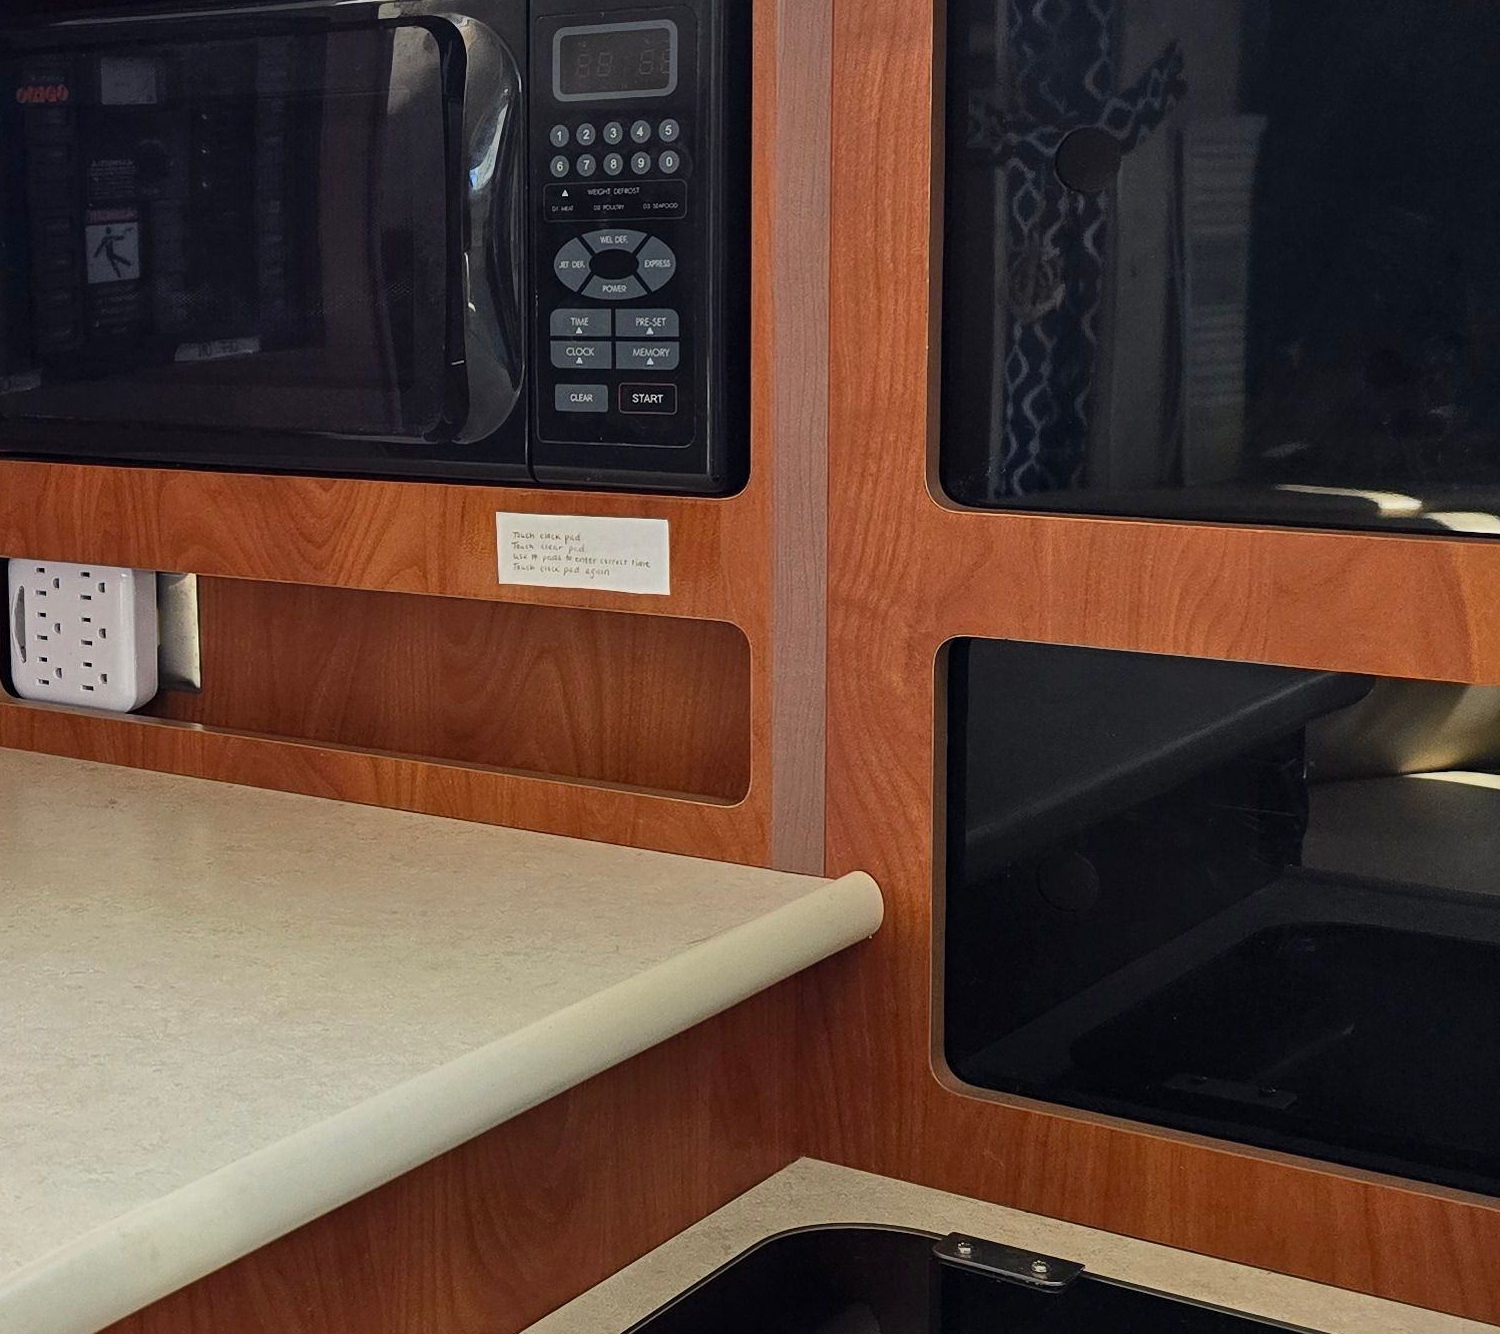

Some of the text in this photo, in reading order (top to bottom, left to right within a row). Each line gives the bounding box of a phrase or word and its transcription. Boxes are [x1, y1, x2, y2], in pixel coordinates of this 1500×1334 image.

[583, 129, 590, 140] 2
[610, 128, 617, 139] 3
[636, 126, 644, 137] 4
[665, 125, 673, 135] 5
[557, 131, 562, 141] 1
[556, 161, 564, 172] 6
[583, 160, 590, 170] 7
[610, 159, 617, 169] 8
[637, 158, 645, 168] 9
[666, 157, 673, 167] 0
[587, 187, 640, 196] WEIGHT DEFROST
[644, 259, 671, 268] EXPRESS
[602, 284, 626, 293] POWER
[570, 317, 589, 326] TIME
[635, 317, 667, 327] PRE-SET
[565, 347, 595, 357] CLOCK
[632, 348, 670, 357] MEMORY
[570, 393, 593, 402] CLEAR
[632, 394, 664, 404] START
[512, 531, 535, 539] Touch
[565, 532, 581, 544] pad
[511, 541, 534, 550] Touch
[568, 543, 585, 554] pad
[575, 556, 596, 564] enter
[600, 556, 627, 566] correct
[631, 559, 651, 568] time
[513, 562, 535, 571] Touch
[563, 565, 580, 576] pad
[585, 568, 610, 580] again
